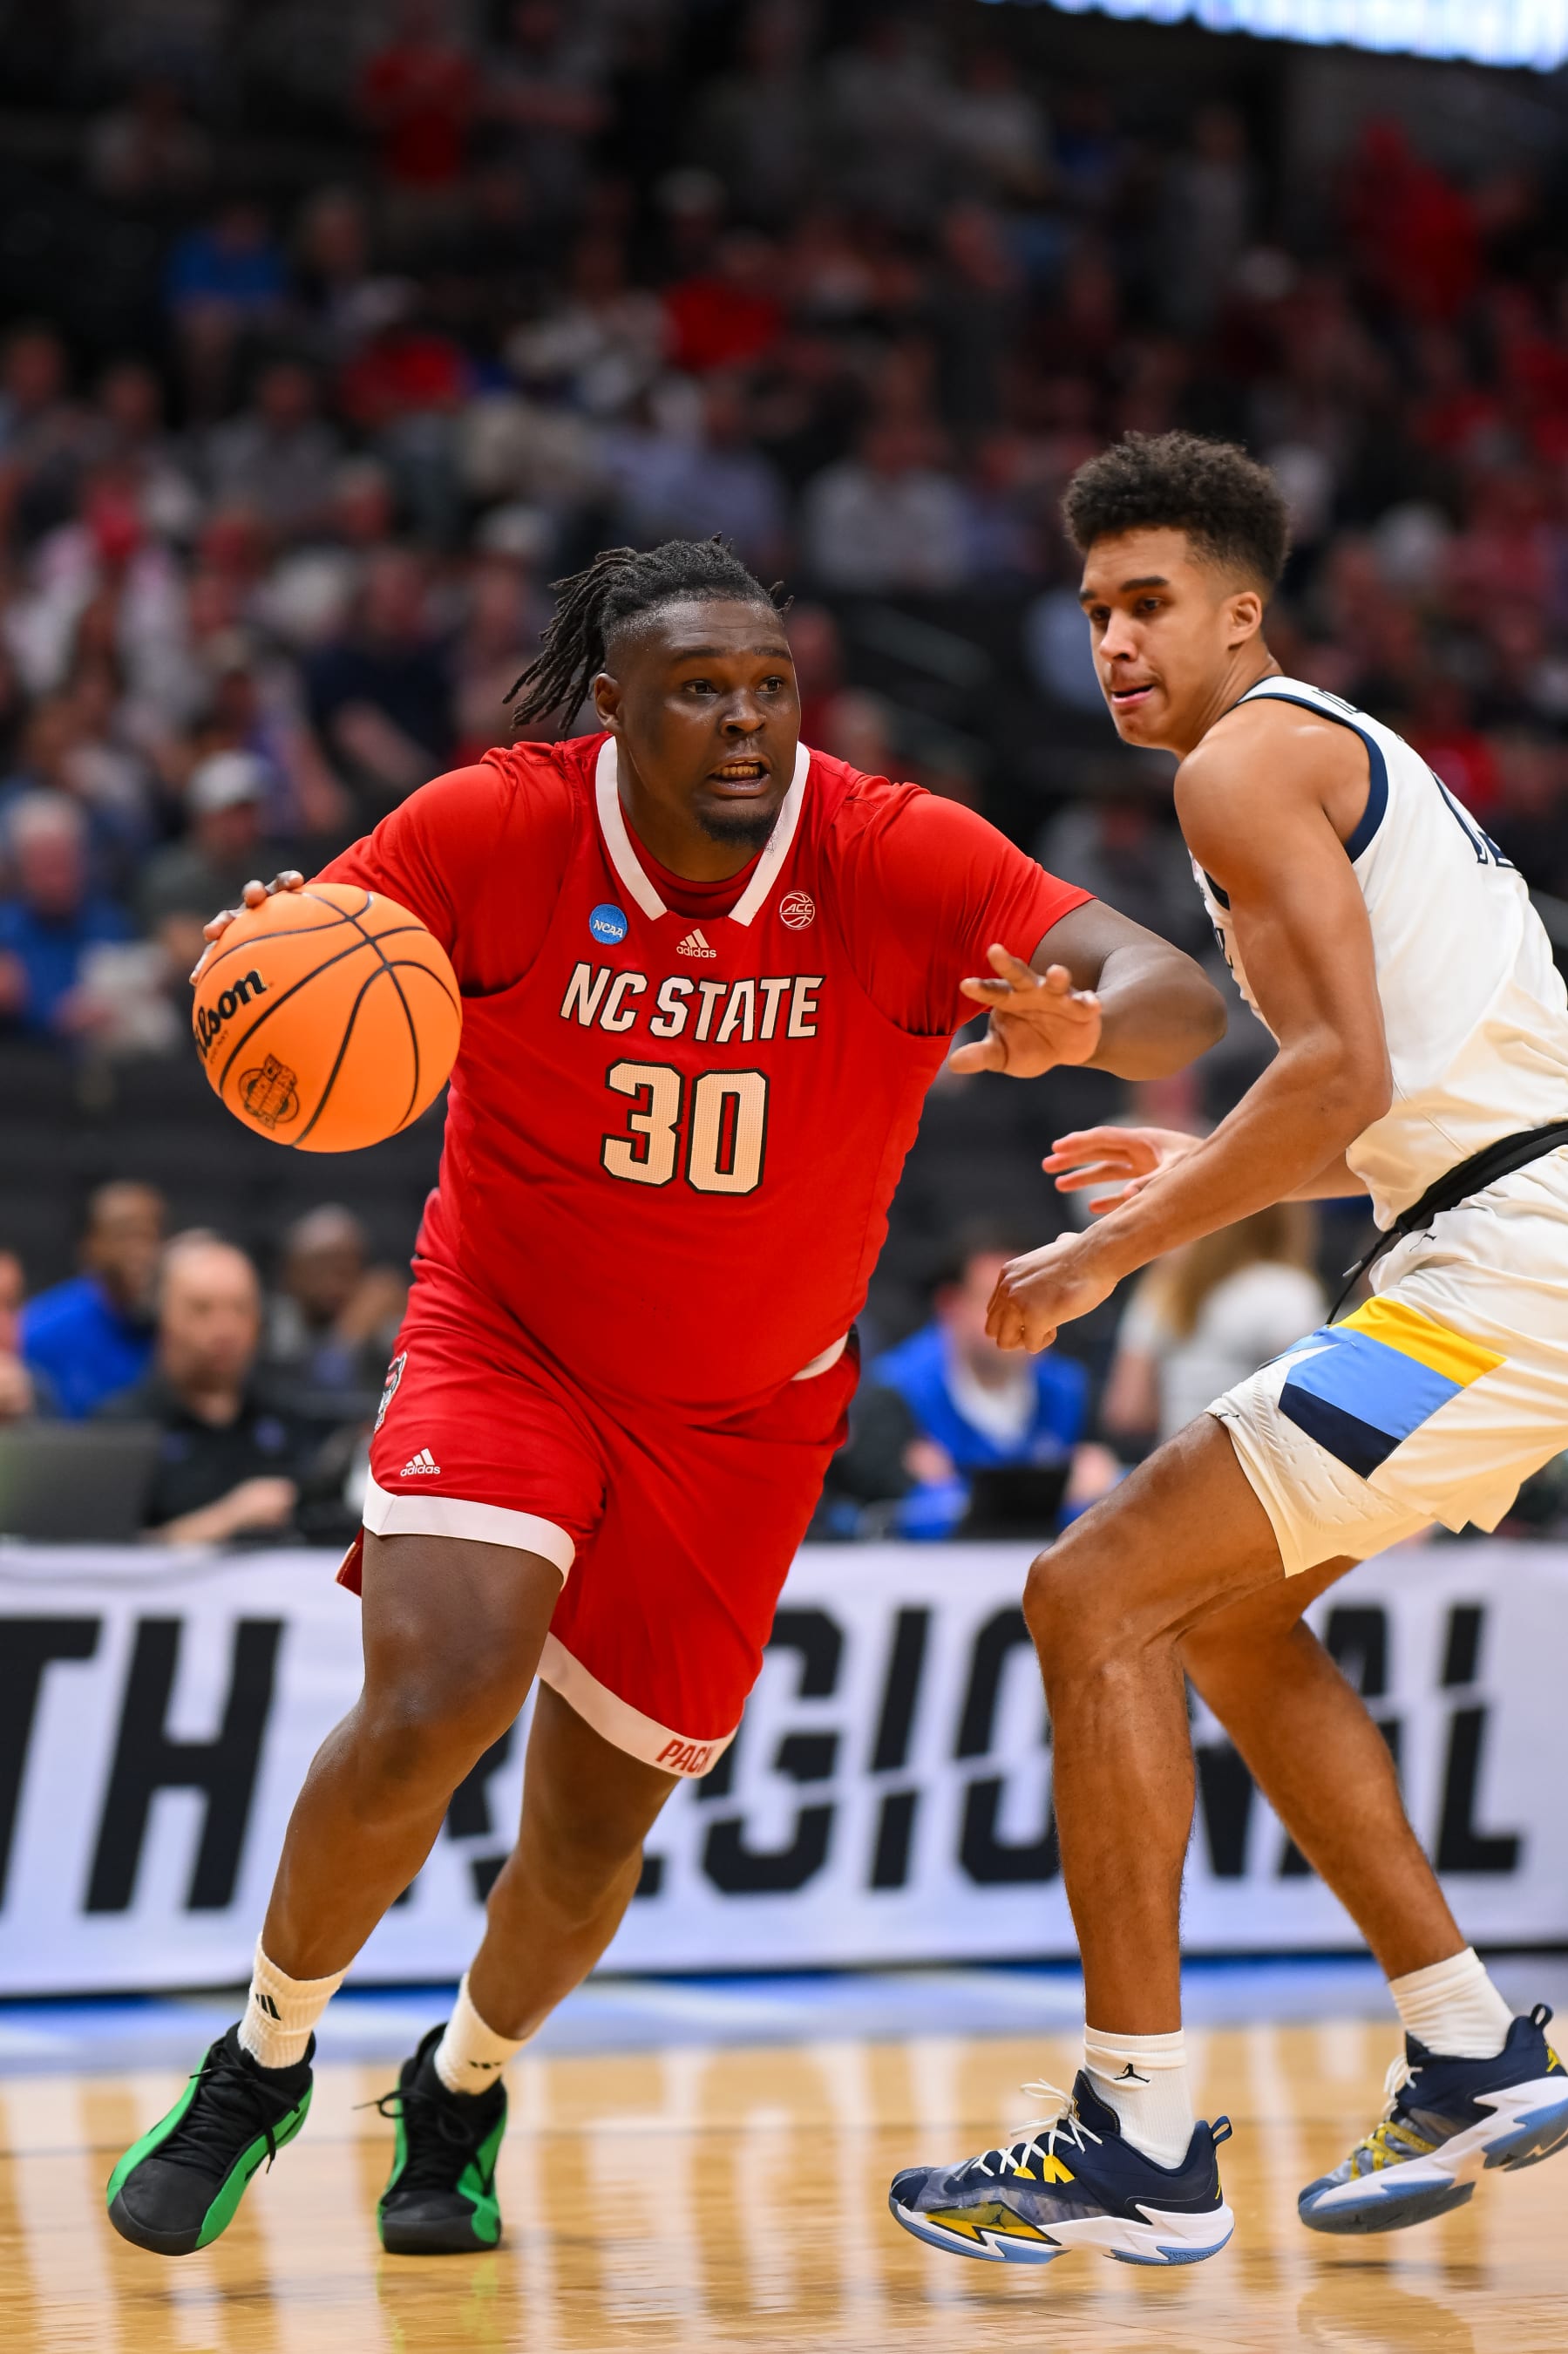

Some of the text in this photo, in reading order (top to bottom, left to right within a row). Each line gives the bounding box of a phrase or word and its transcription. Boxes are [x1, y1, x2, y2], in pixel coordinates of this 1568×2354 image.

[784, 903, 814, 913] ACC
[593, 919, 623, 938] NCAA
[676, 945, 716, 958] adidas
[560, 960, 826, 1044] NC STATE
[195, 969, 267, 1058] ilson
[600, 1058, 770, 1196] 30
[400, 1465, 441, 1477] adidas
